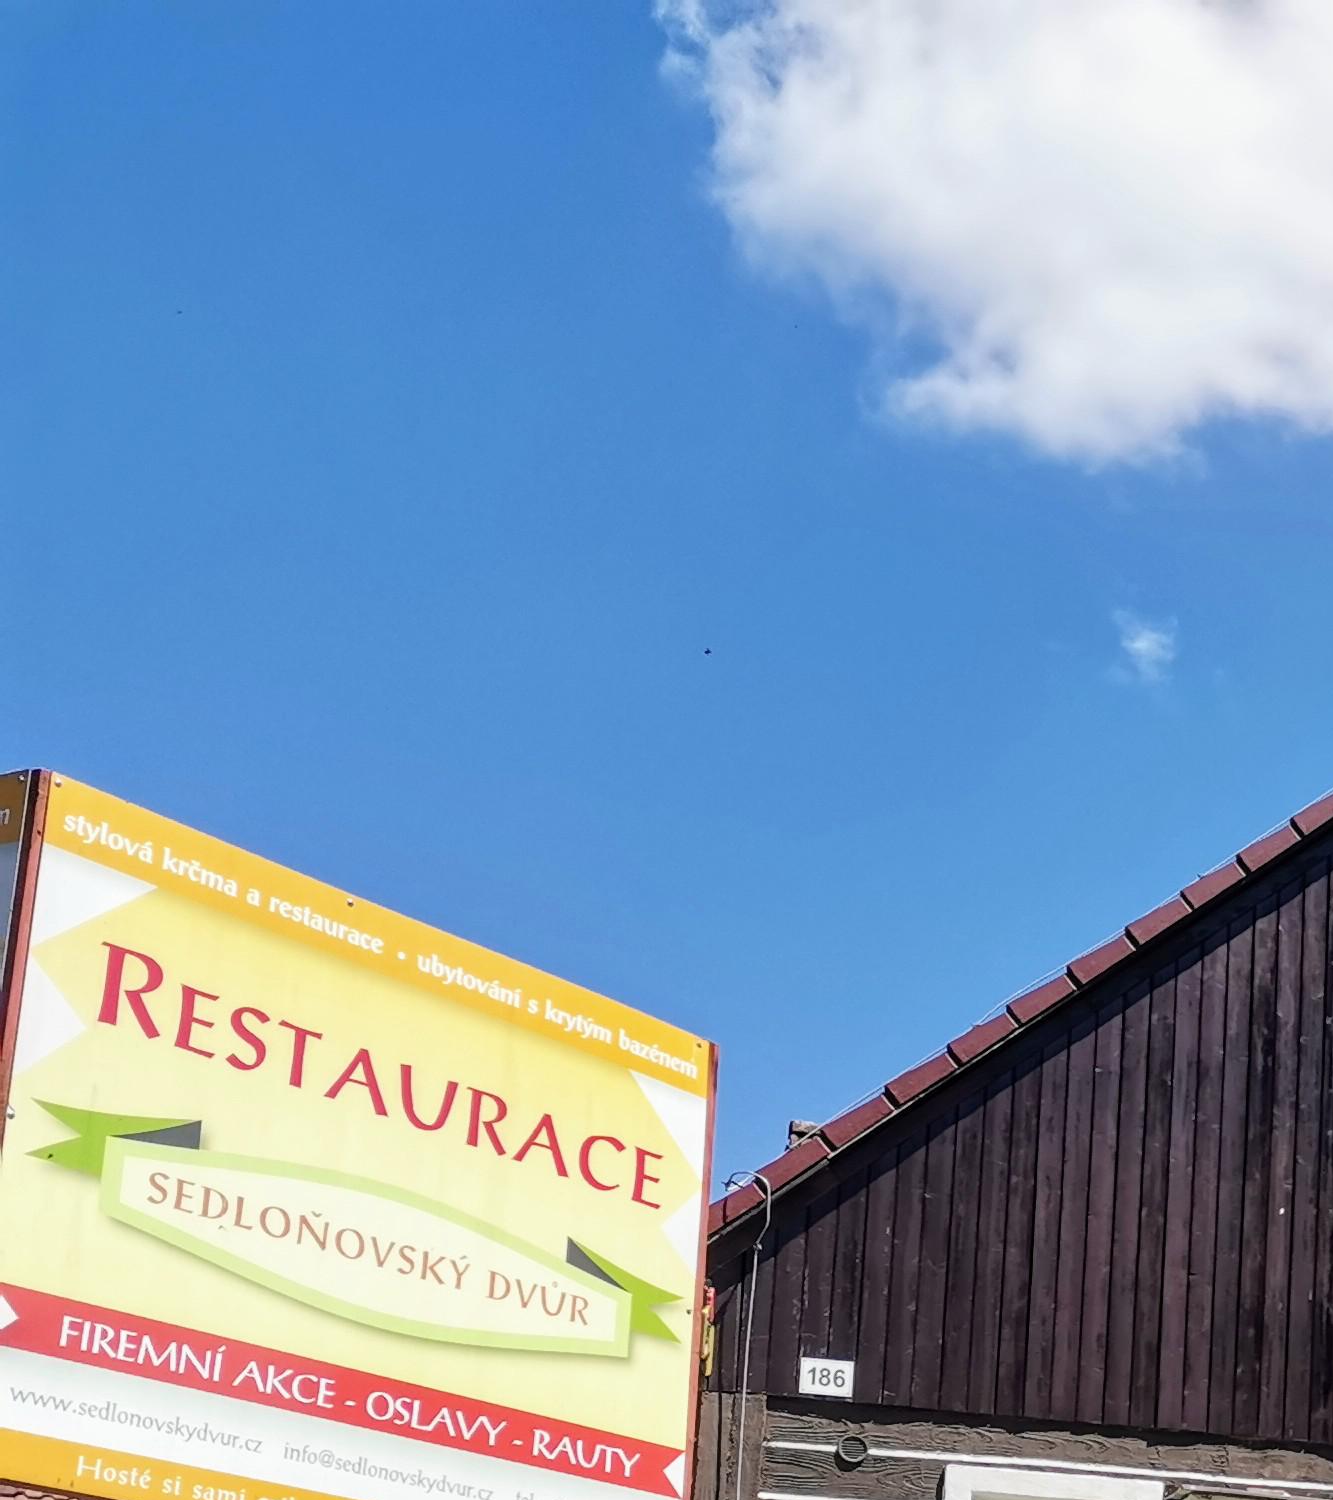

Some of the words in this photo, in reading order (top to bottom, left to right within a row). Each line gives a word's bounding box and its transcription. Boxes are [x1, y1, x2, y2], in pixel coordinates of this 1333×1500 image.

[64, 814, 153, 864] stylová
[162, 847, 238, 897] krčma
[246, 887, 261, 906] a
[269, 896, 384, 954] restaurace
[416, 954, 522, 1008] ubytování
[527, 997, 539, 1014] s
[545, 999, 612, 1044] krytým
[619, 1029, 698, 1080] bazénem
[97, 941, 664, 1209] RESTAURACE
[146, 1172, 471, 1290] SEDLOŇOVSKÝ
[486, 1270, 589, 1325] DVŮR
[9, 1386, 263, 1454] www.sedlonovskydvur.cz
[59, 1315, 226, 1382] FIREMNÍ
[232, 1361, 336, 1408] AKCE
[366, 1391, 507, 1446] OSLAVY
[531, 1429, 640, 1478] RAUTY
[808, 1367, 845, 1388] 186
[76, 1455, 151, 1489] Hosté
[162, 1476, 182, 1496] si
